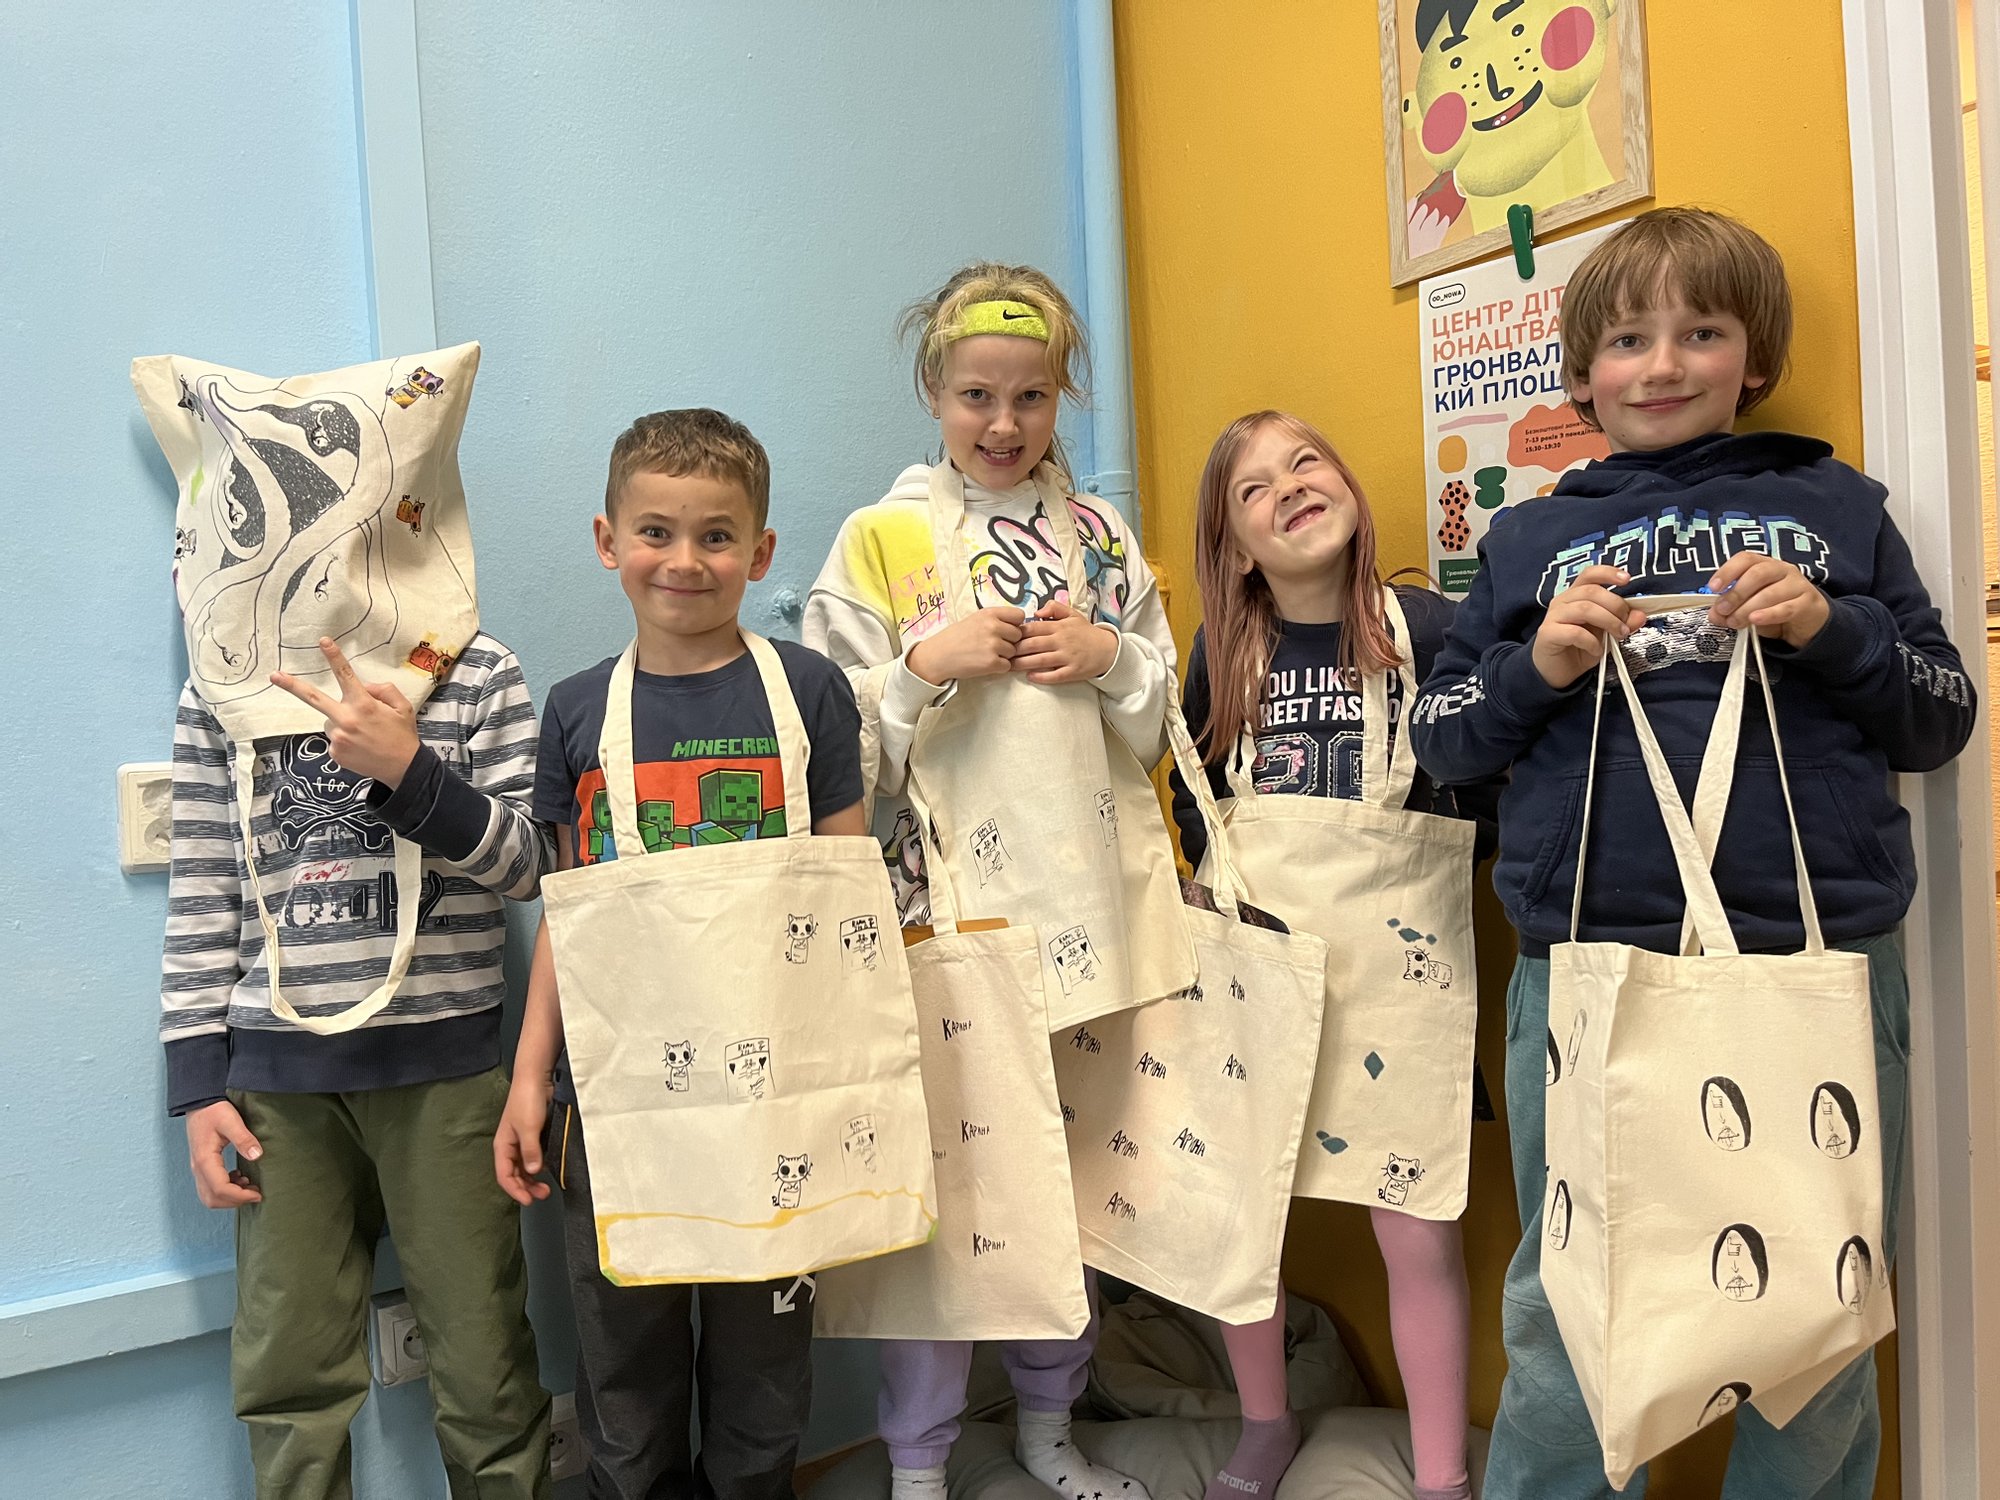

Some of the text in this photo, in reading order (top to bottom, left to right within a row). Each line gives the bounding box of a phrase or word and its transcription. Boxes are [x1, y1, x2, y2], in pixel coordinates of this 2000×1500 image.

[1432, 285, 1565, 339] ЦЕНТР ДІТ
[1434, 342, 1560, 389] ГРЮНВАЛ
[1435, 381, 1473, 413] КІЙ
[1267, 669, 1297, 699] OU
[1305, 666, 1358, 693] LIKE
[1258, 697, 1313, 729] REET
